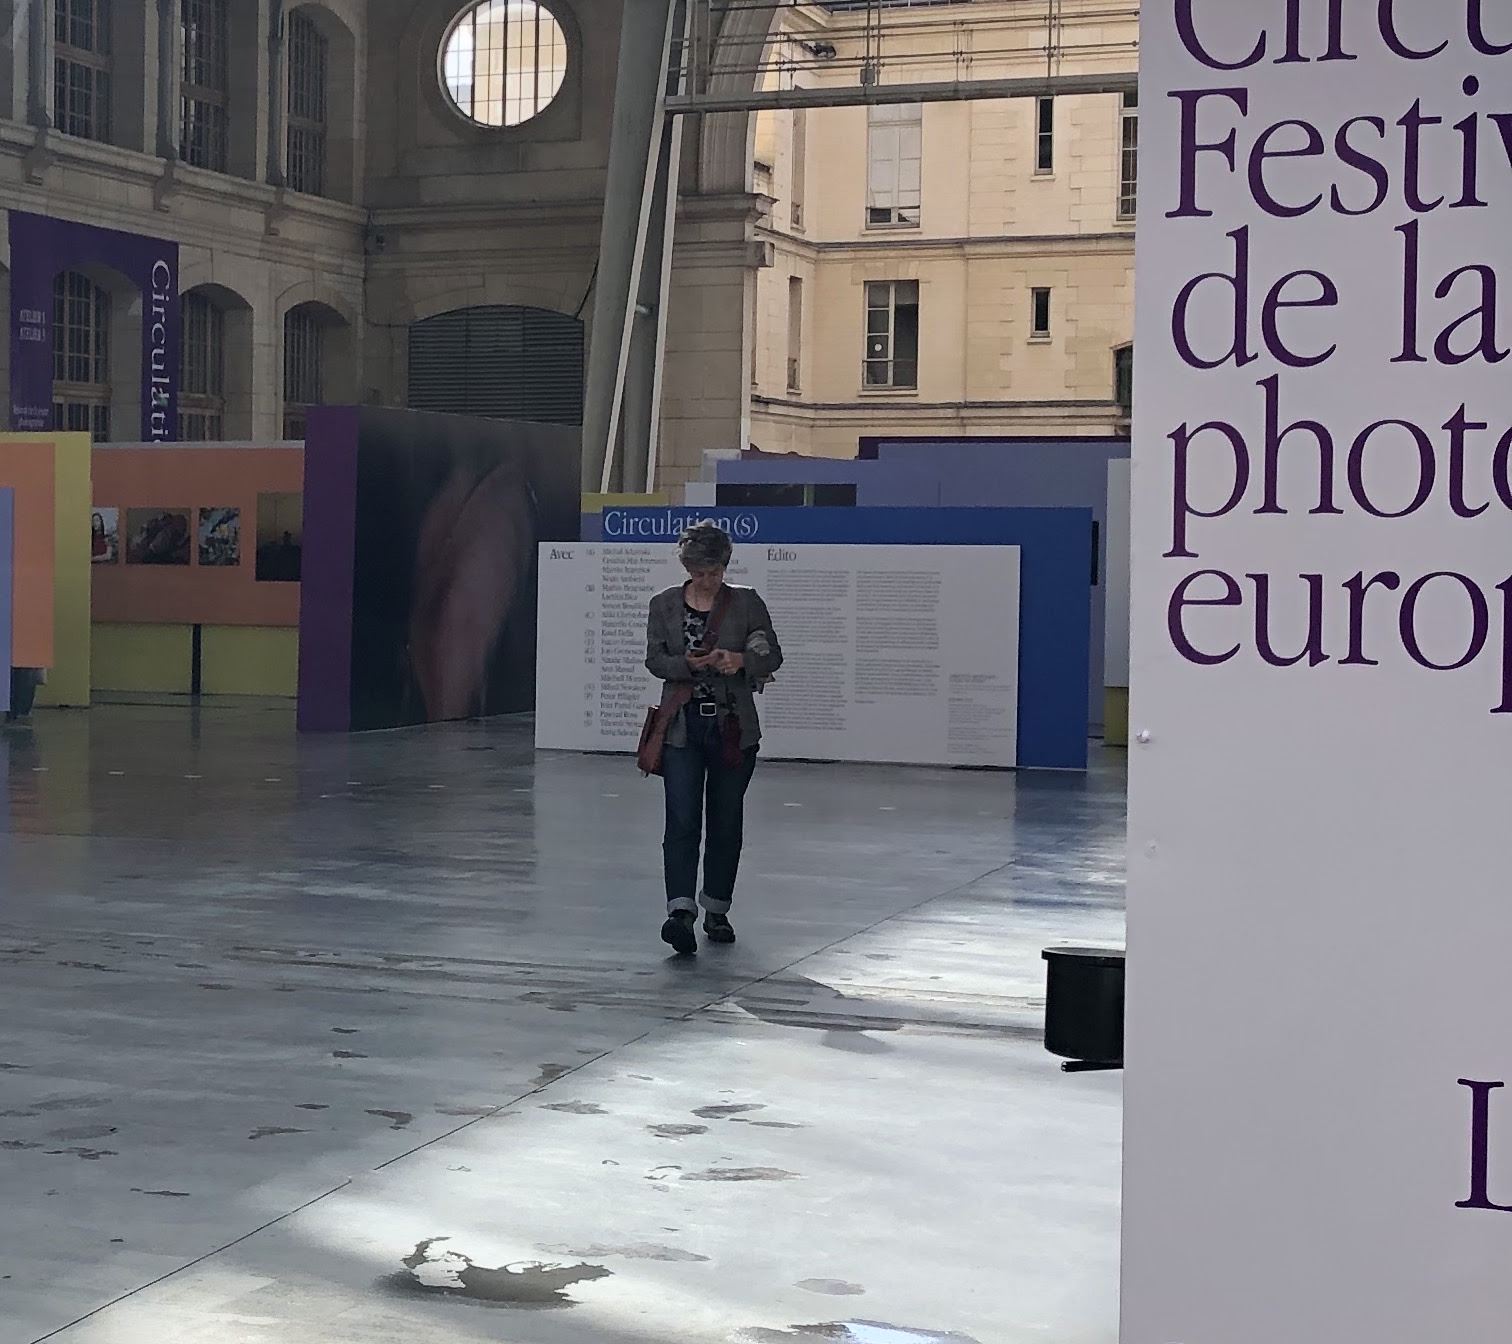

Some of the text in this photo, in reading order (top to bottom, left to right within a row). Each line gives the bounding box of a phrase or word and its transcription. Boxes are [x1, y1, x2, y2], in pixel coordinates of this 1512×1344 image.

[150, 259, 171, 443] Circulati
[1171, 218, 1511, 370] de la
[1162, 373, 1512, 559] phot
[550, 549, 574, 560] Avec
[1167, 569, 1512, 714] euro
